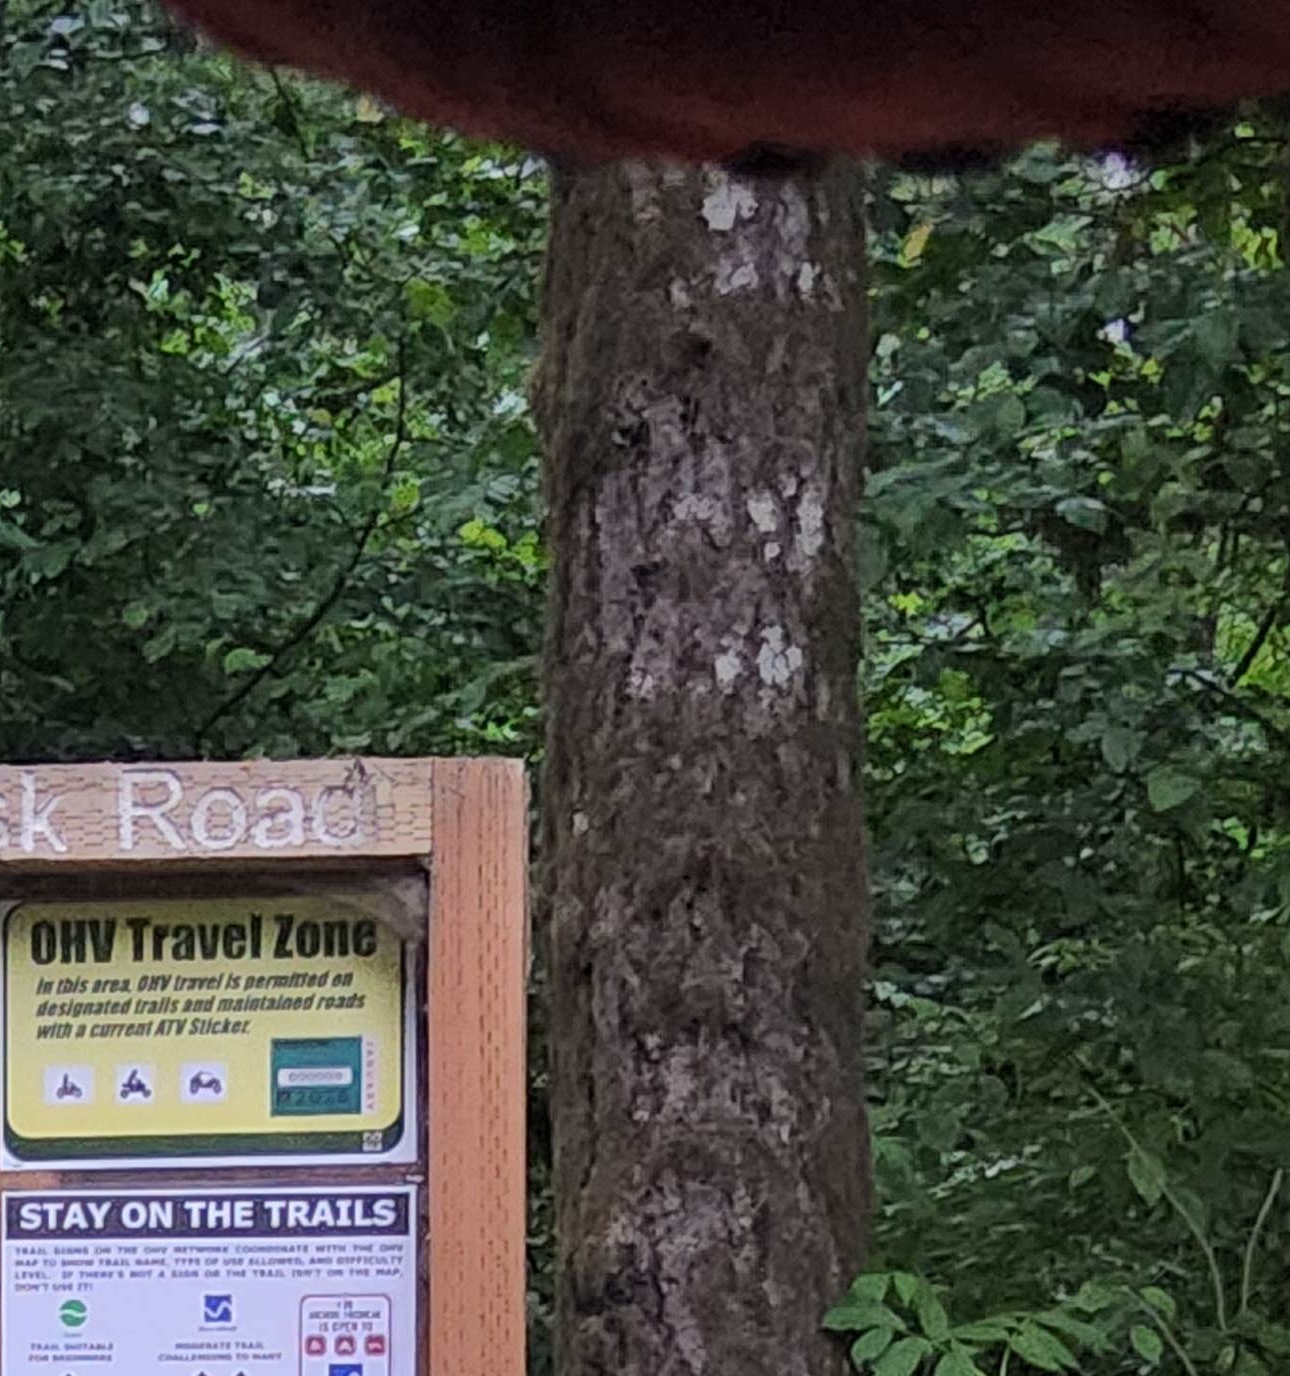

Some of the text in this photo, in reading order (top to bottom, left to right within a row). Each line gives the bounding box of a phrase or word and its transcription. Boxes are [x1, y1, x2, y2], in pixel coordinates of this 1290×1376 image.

[119, 766, 368, 852] Road
[30, 912, 378, 965] OHV Travel Zone
[37, 977, 54, 995] In
[57, 976, 88, 994] this
[137, 974, 169, 992] OHV
[173, 973, 223, 991] travel
[225, 972, 240, 990] is
[243, 971, 327, 991] permitted
[331, 972, 354, 988] on
[36, 992, 366, 1018] designated trails and maintained roads
[37, 1016, 251, 1039] with a current ATV Sticker.
[19, 1198, 397, 1230] STAY ON THE TRAILS
